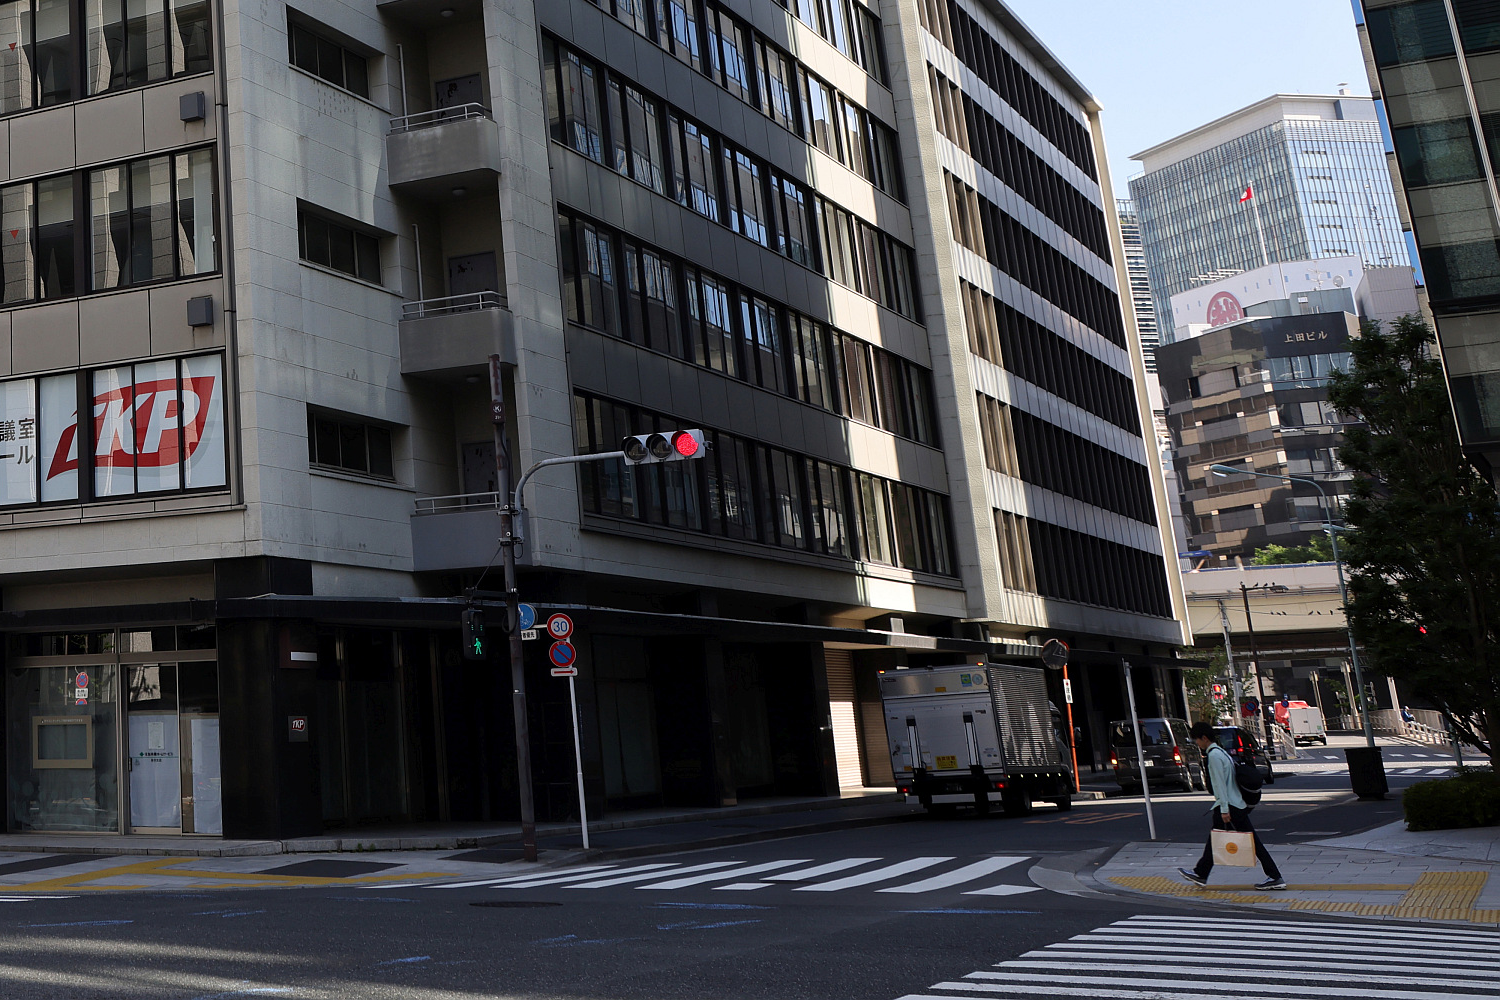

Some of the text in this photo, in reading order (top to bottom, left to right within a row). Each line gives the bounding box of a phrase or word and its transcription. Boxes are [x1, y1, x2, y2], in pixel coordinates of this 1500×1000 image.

[1284, 331, 1328, 343] 上田ビル
[553, 621, 568, 632] 30
[292, 719, 304, 729] TKP
